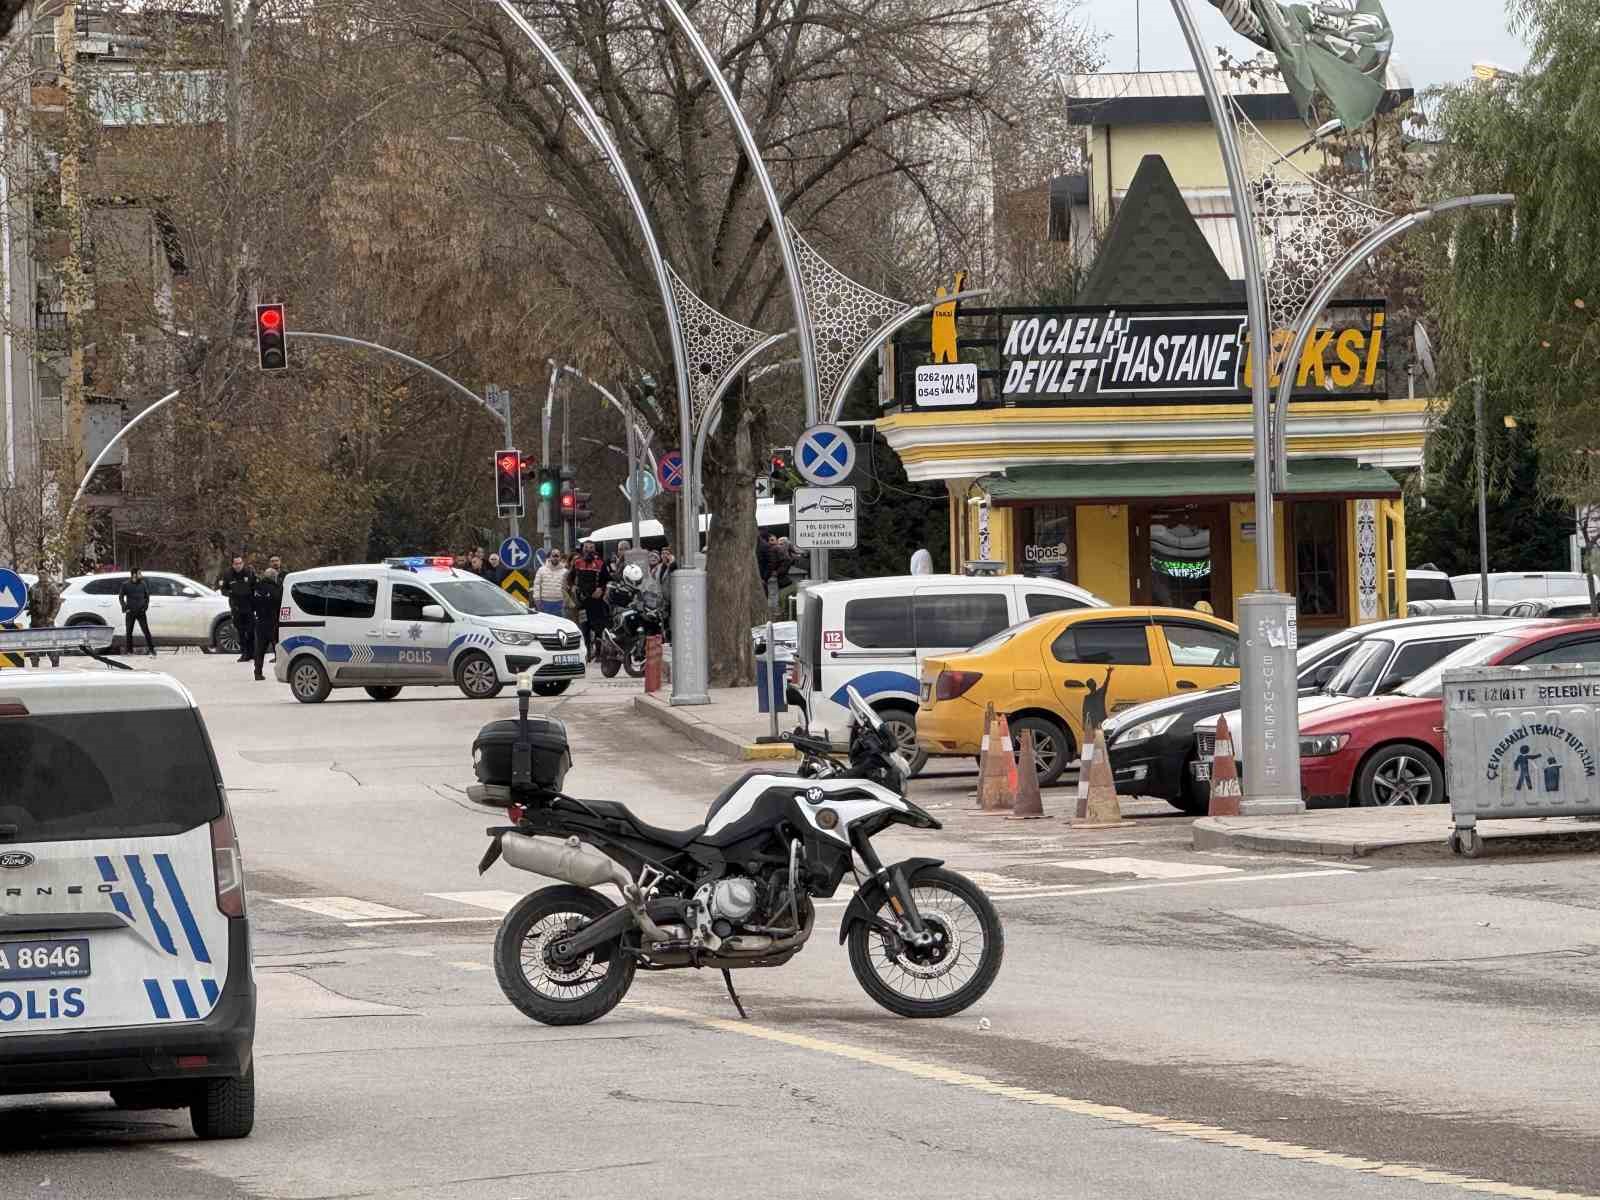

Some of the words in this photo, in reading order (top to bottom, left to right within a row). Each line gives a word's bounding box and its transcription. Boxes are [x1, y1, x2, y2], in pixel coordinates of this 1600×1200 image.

[1002, 310, 1116, 356] KOCAELİ
[1111, 333, 1235, 383] HASTANE
[917, 372, 940, 382] 0262
[941, 374, 954, 394] 322
[955, 374, 965, 394] 43
[966, 373, 976, 393] 34
[1002, 359, 1098, 394] DEVLET
[917, 388, 940, 397] 0545
[826, 632, 842, 642] 112
[17, 946, 80, 969] 8646
